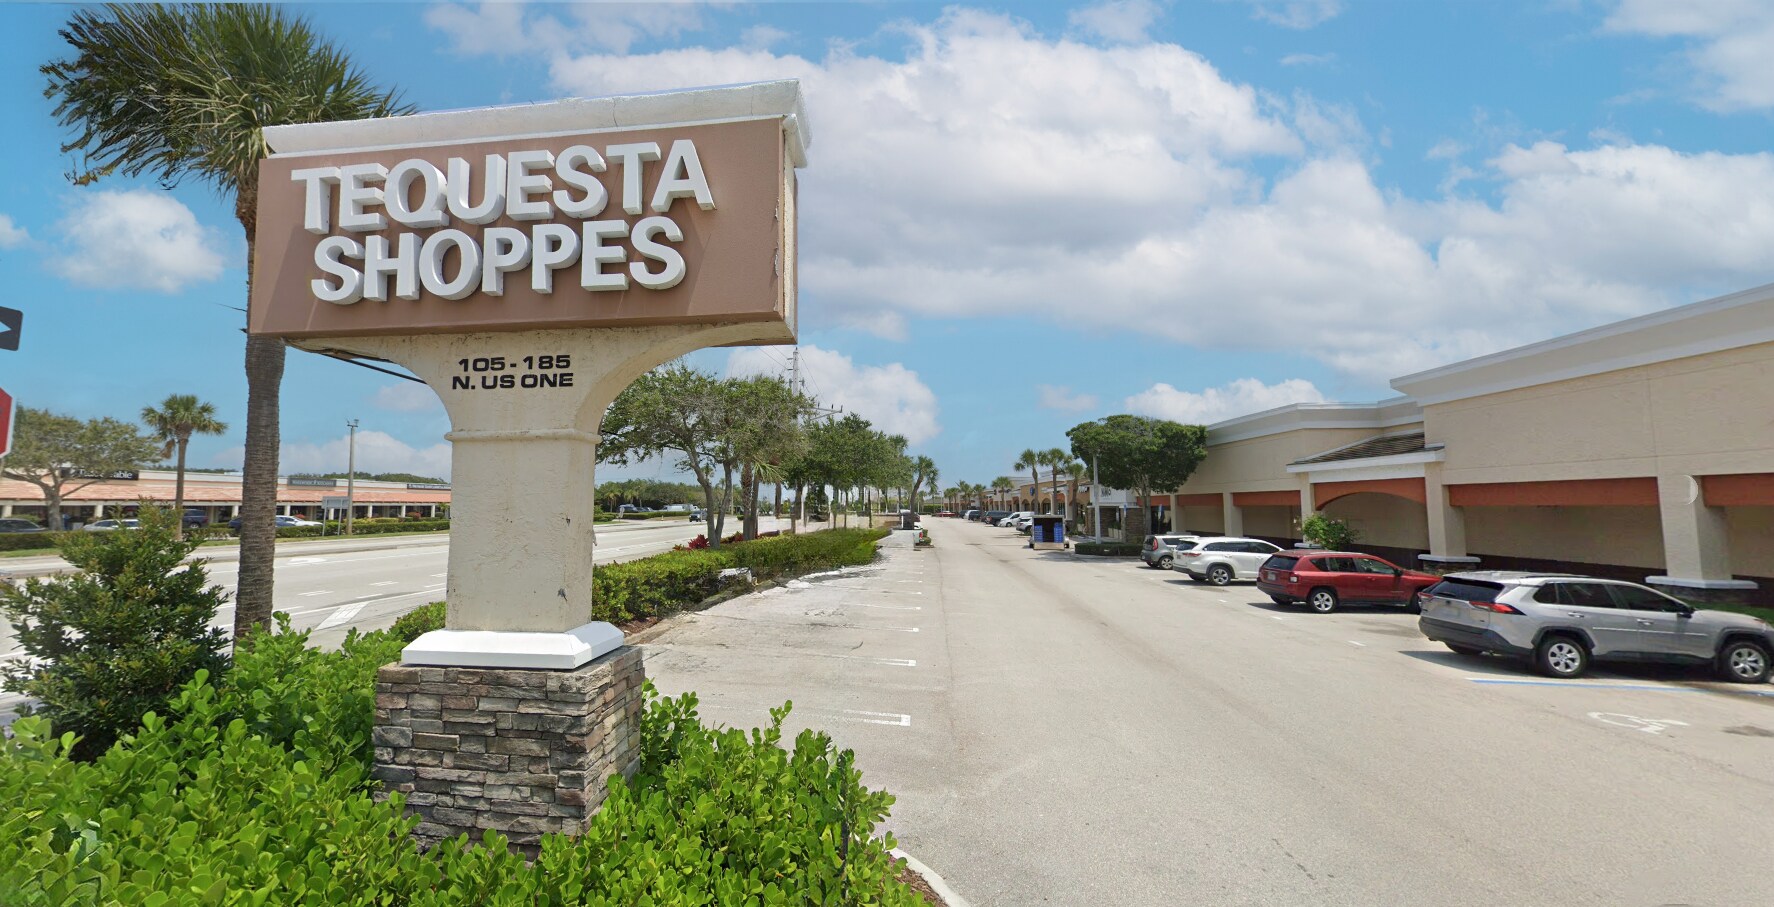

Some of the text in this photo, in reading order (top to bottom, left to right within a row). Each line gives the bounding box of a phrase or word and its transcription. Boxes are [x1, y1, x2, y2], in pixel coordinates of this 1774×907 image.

[290, 139, 716, 235] TEQUESTA
[310, 217, 687, 306] SHOPPES
[452, 373, 574, 390] N. US ONE
[458, 357, 506, 372] 105
[523, 355, 571, 370] 185
